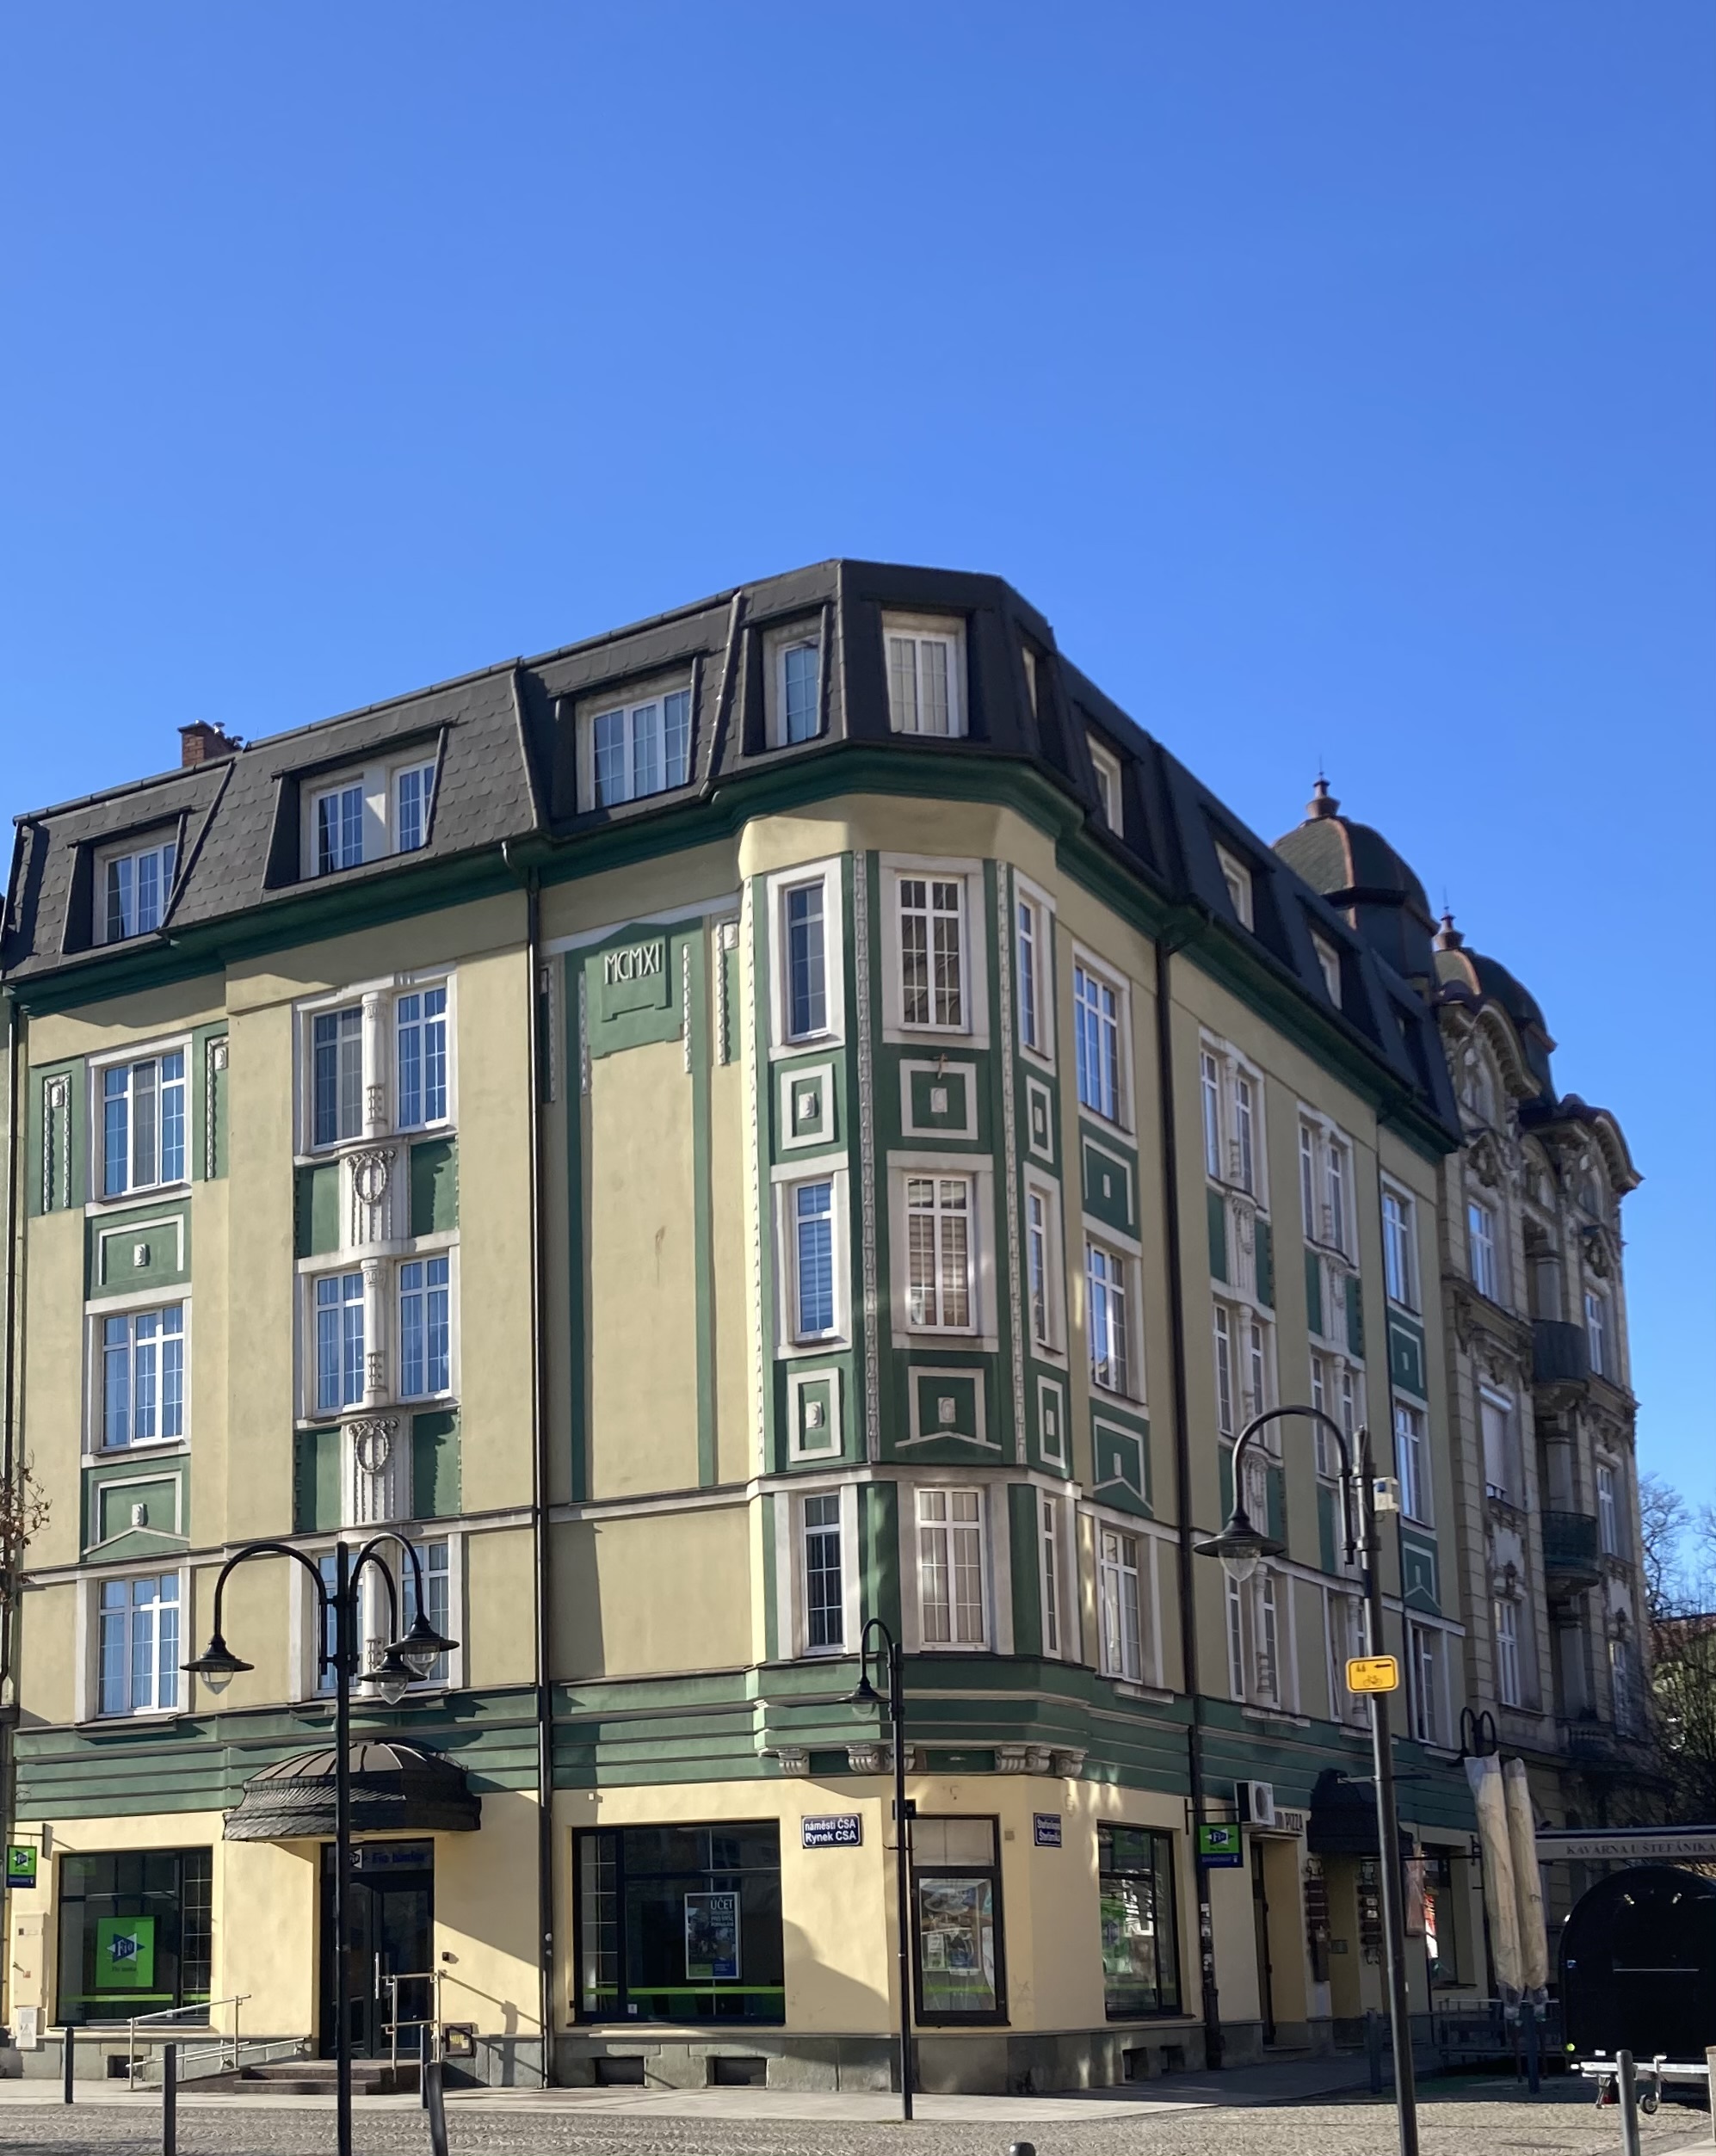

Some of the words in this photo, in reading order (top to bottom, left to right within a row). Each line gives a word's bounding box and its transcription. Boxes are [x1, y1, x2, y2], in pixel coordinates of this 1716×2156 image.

[604, 943, 660, 985] MCMXI
[837, 1817, 856, 1829] ČSA
[805, 1832, 834, 1845] Rynek
[1642, 1841, 1716, 1853] ŠTEFÁNIKA
[710, 1896, 733, 1910] ÚČET
[117, 1938, 133, 1956] Fio
